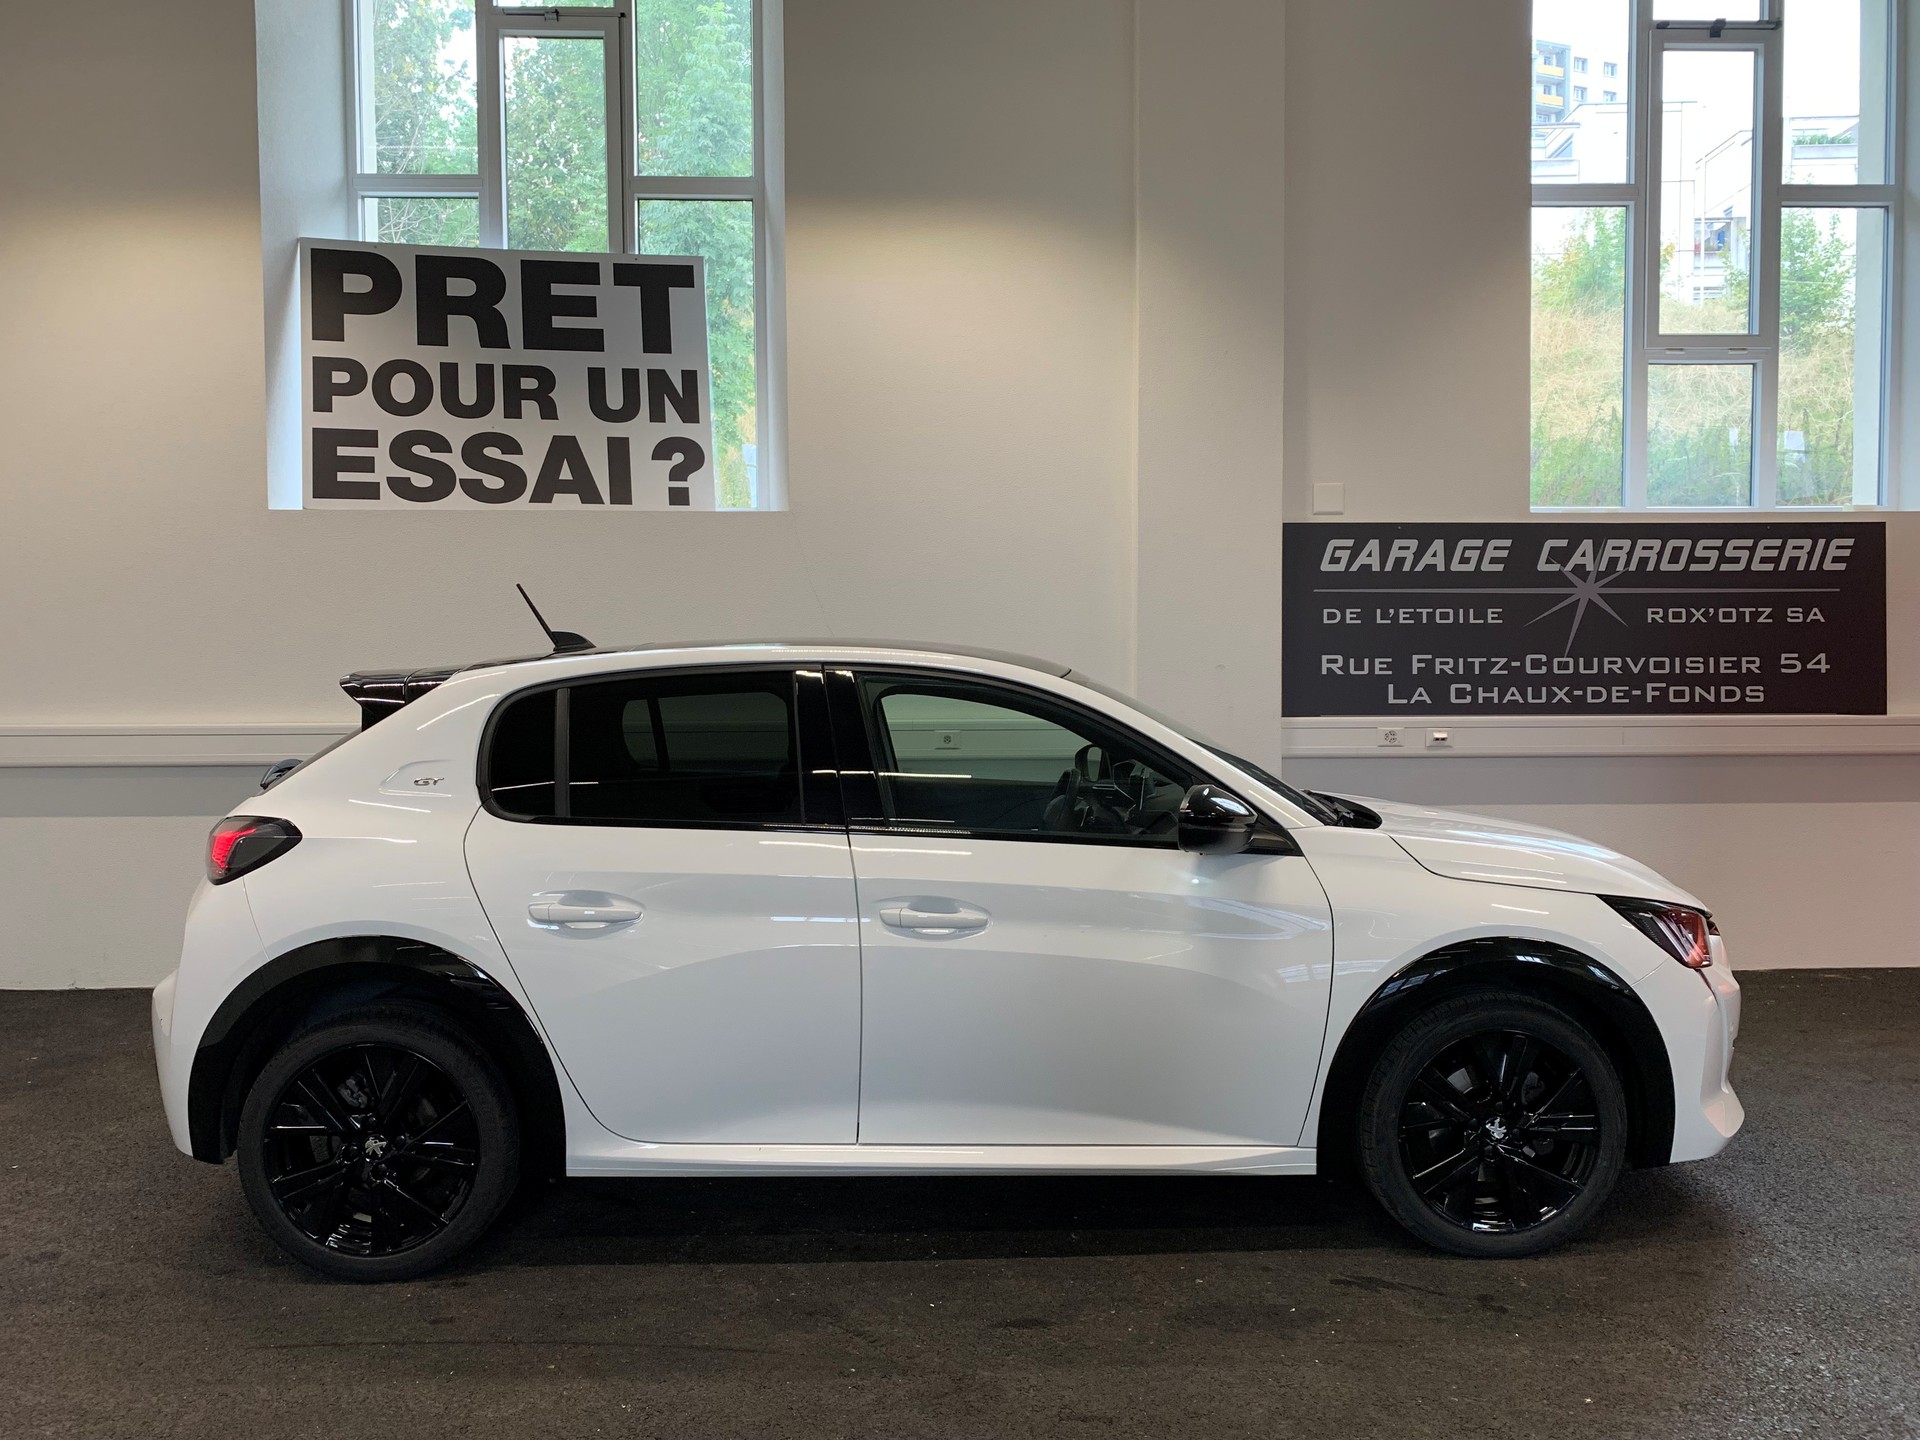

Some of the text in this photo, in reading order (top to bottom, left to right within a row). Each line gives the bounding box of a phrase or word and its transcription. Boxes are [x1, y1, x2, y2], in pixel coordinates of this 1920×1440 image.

[310, 248, 694, 354] PRET
[312, 356, 700, 423] POUR UN
[1320, 538, 1855, 572] GARAGE CARROSSERIE
[1323, 607, 1503, 624] DE L'ETOILE
[1787, 607, 1825, 623] SA
[1321, 654, 1393, 675] RUE
[1780, 653, 1830, 674] 54
[1388, 683, 1433, 704] LA
[413, 777, 445, 787] GT
